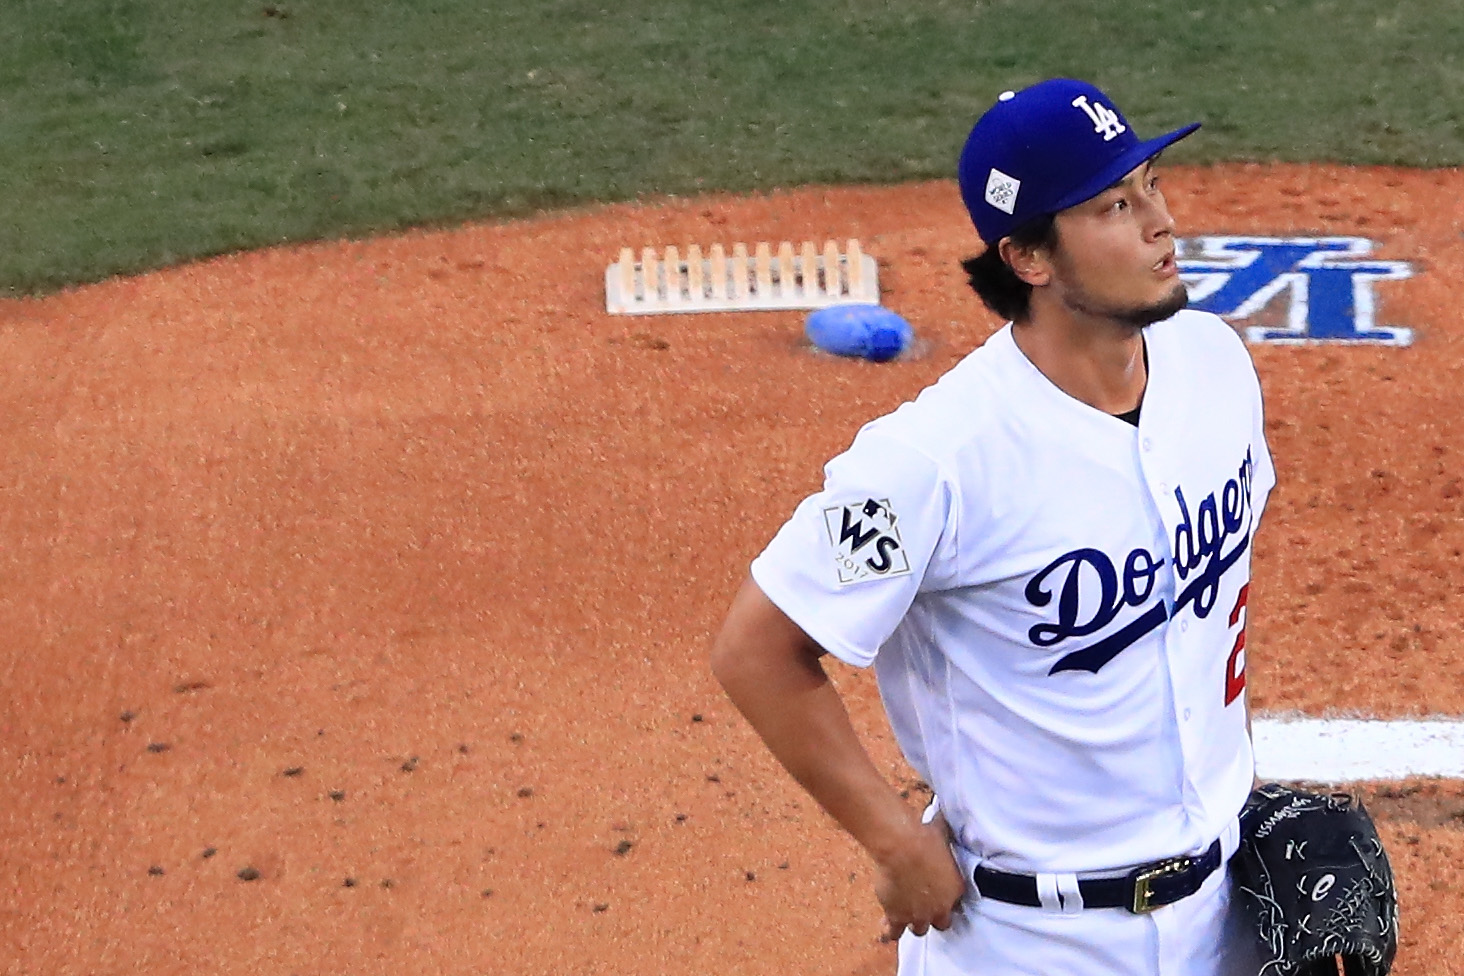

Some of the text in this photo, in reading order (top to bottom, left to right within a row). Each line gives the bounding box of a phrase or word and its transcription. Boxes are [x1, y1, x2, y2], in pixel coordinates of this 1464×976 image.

[1072, 95, 1126, 141] LA
[839, 505, 900, 574] WS
[1025, 443, 1252, 647] Dodger
